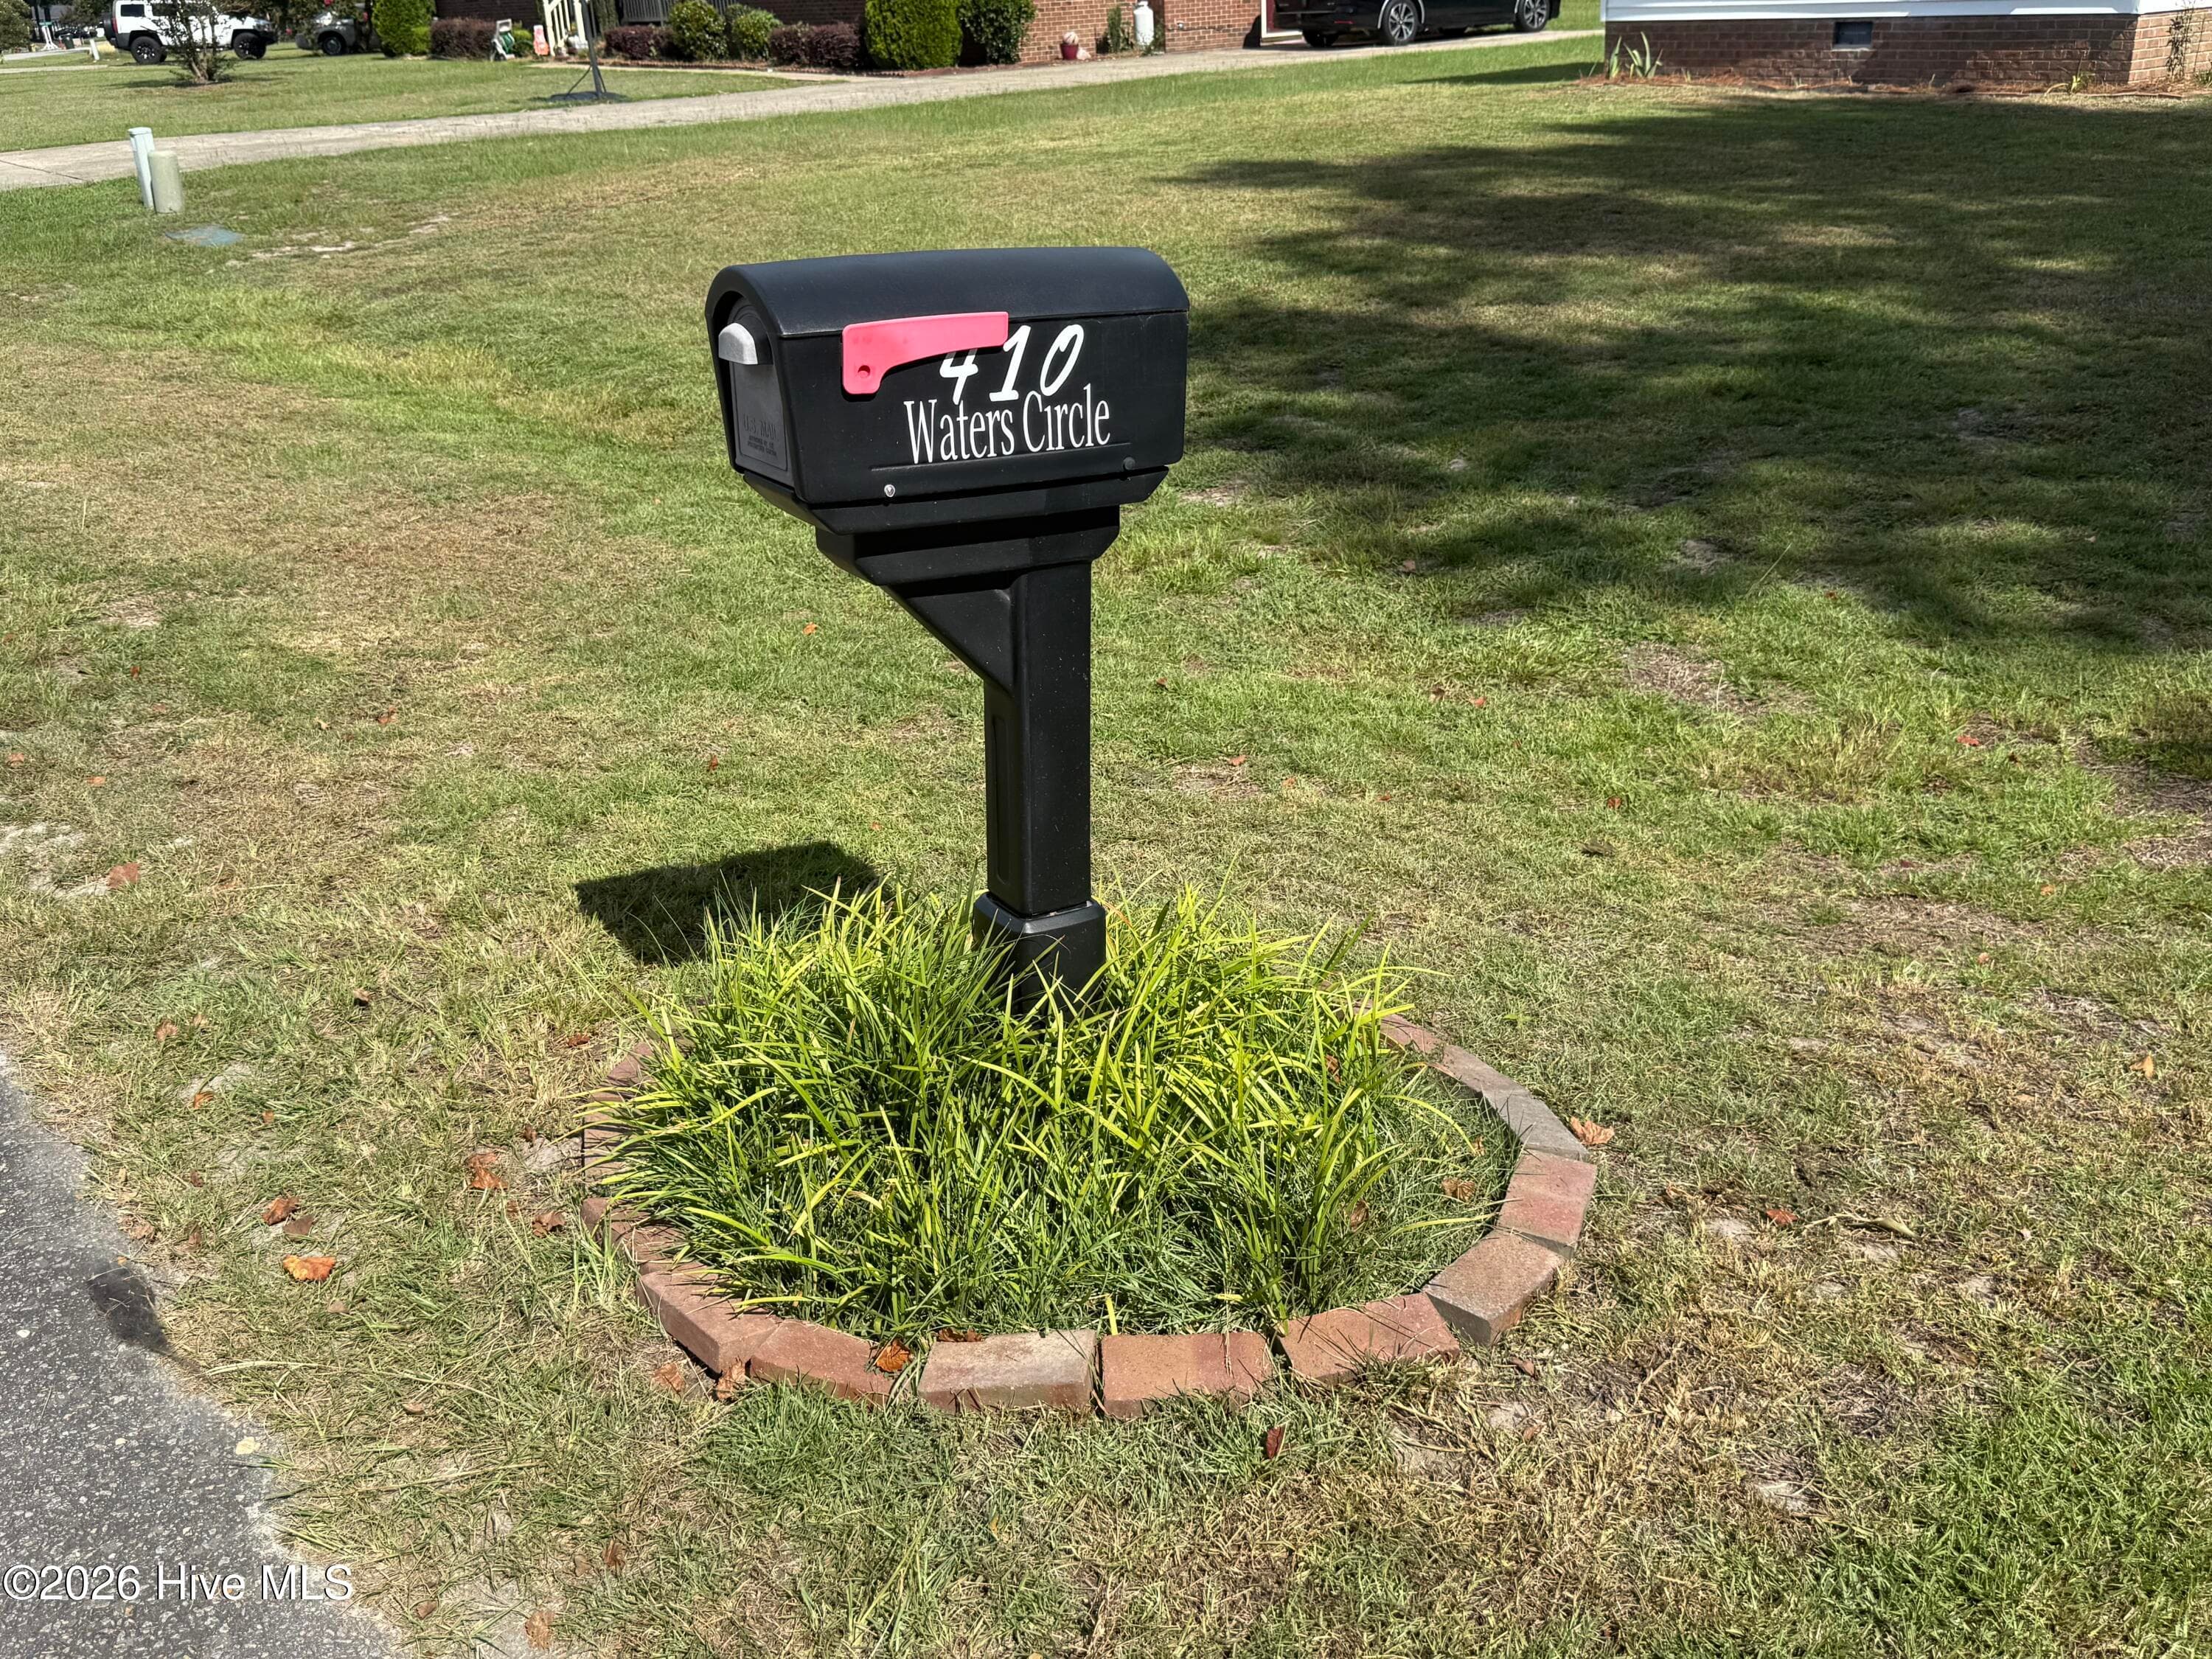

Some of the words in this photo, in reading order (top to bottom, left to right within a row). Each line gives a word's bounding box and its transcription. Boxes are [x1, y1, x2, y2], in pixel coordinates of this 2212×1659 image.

[939, 324, 1085, 406] 410
[903, 398, 1016, 465] Waters
[1022, 383, 1111, 453] Circle
